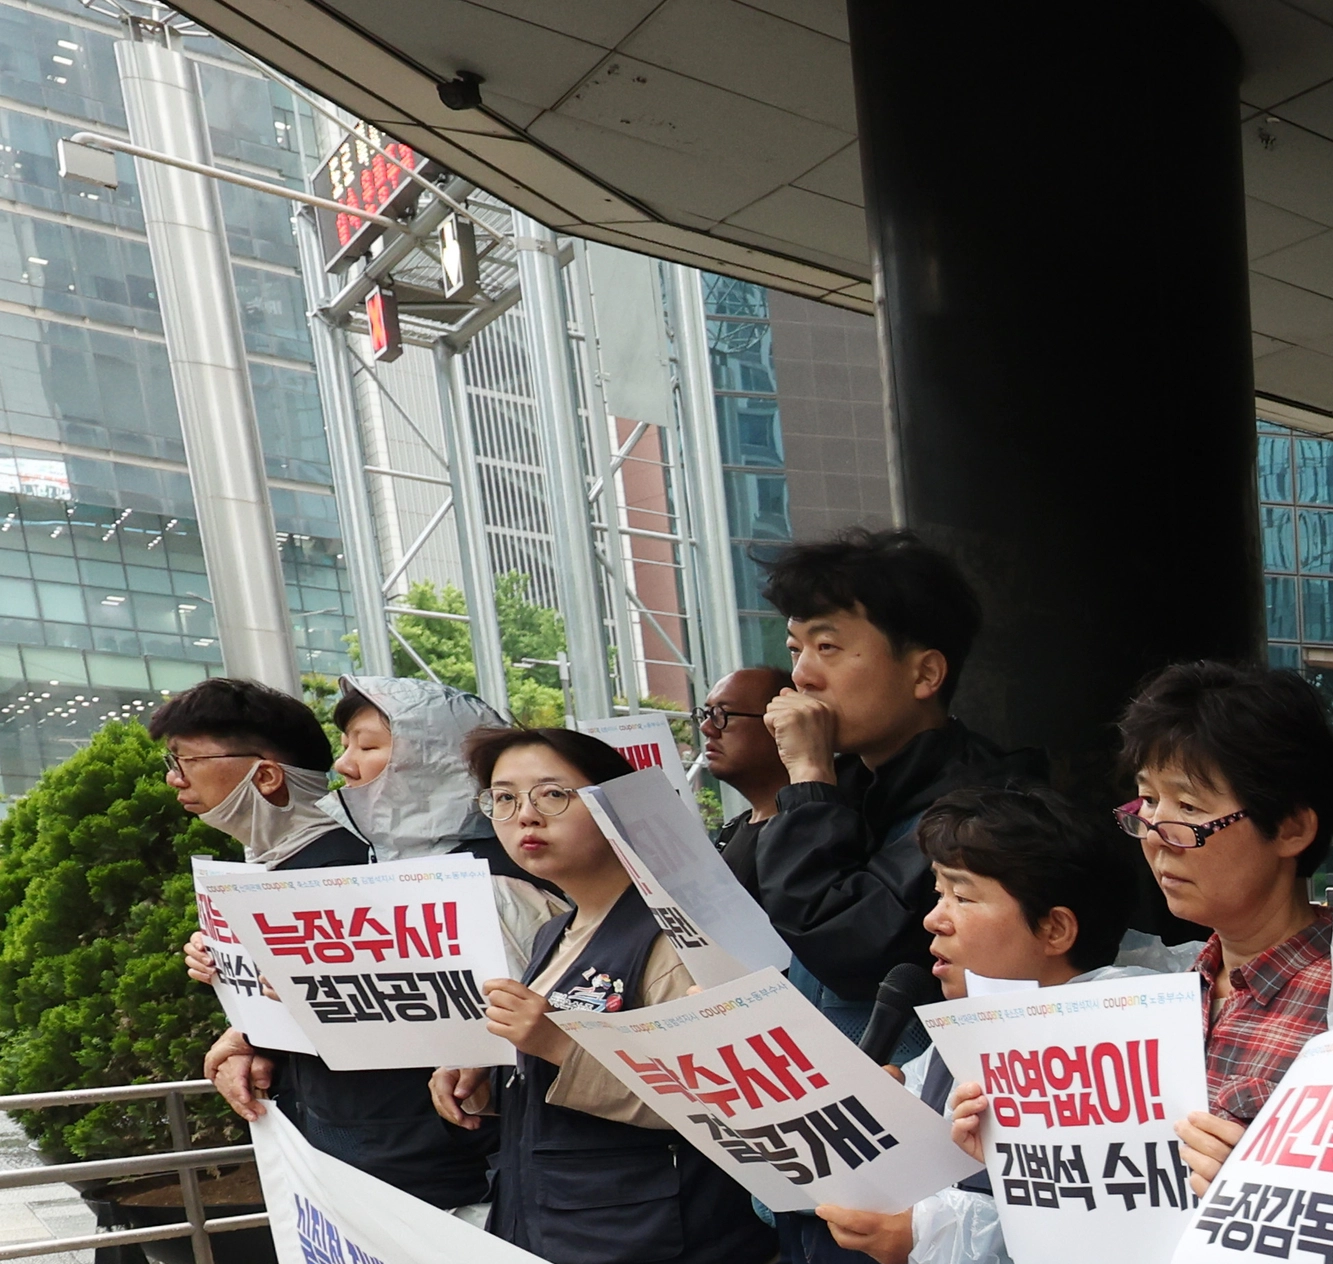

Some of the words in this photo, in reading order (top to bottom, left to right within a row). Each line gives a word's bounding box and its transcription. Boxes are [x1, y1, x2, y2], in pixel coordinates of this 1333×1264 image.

[322, 876, 358, 888] coupang
[398, 872, 443, 883] coupang
[251, 901, 461, 965] 늑장수사!
[291, 969, 487, 1023] 결과공개!
[699, 996, 748, 1019] coupang
[1026, 1001, 1063, 1018] coupang
[1103, 993, 1148, 1010] coupang
[980, 1038, 1166, 1129] 성역없이!
[996, 1142, 1097, 1211] 김범석
